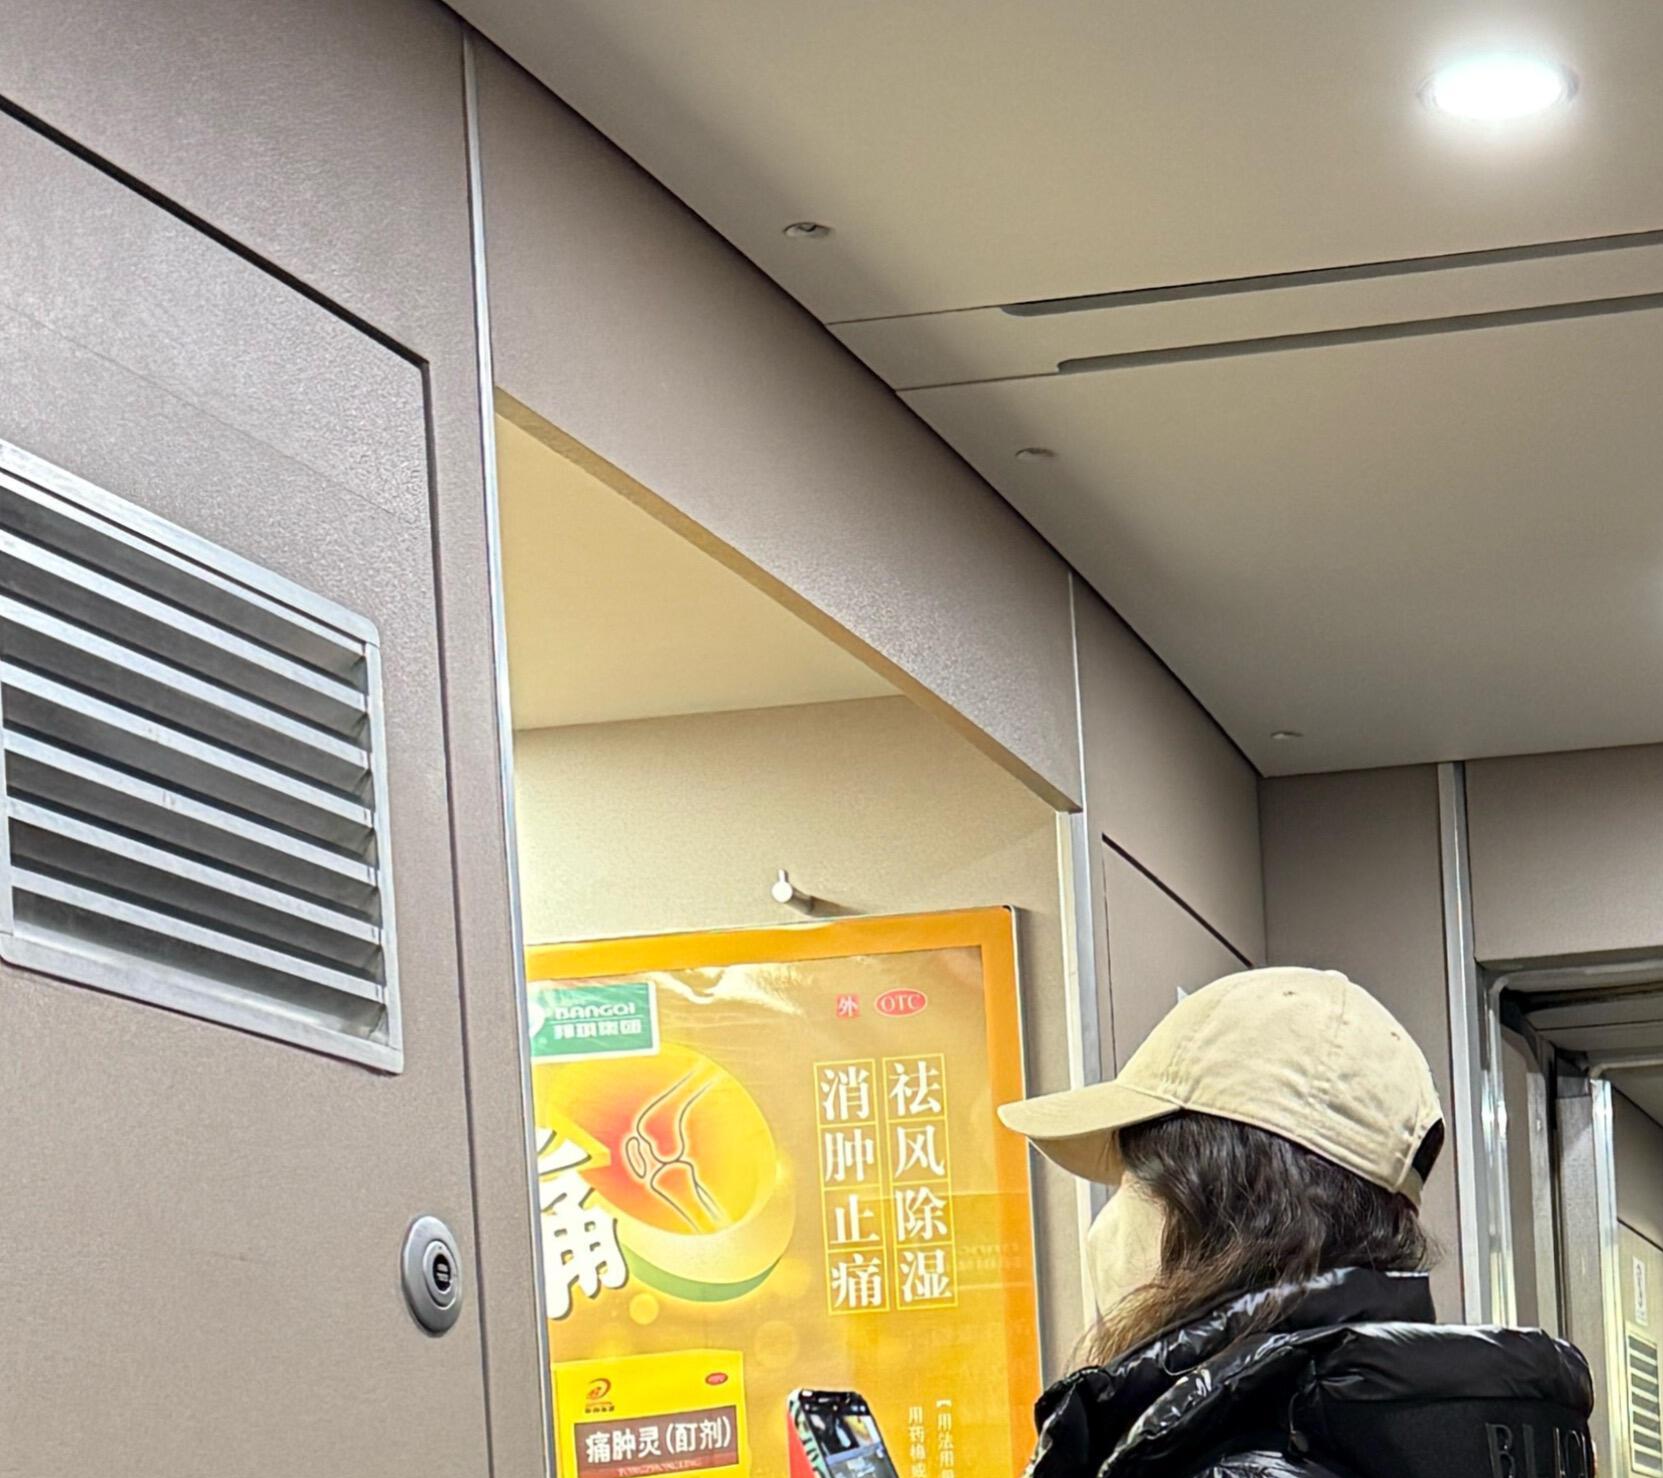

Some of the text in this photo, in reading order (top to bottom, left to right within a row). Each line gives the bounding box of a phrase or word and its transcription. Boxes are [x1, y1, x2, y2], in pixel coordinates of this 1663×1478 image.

[880, 993, 923, 1013] OTC
[820, 1065, 883, 1308] 消肿止痛
[889, 1060, 953, 1303] 祛风除湿
[585, 1415, 732, 1464] 痛肿灵(酊剂)
